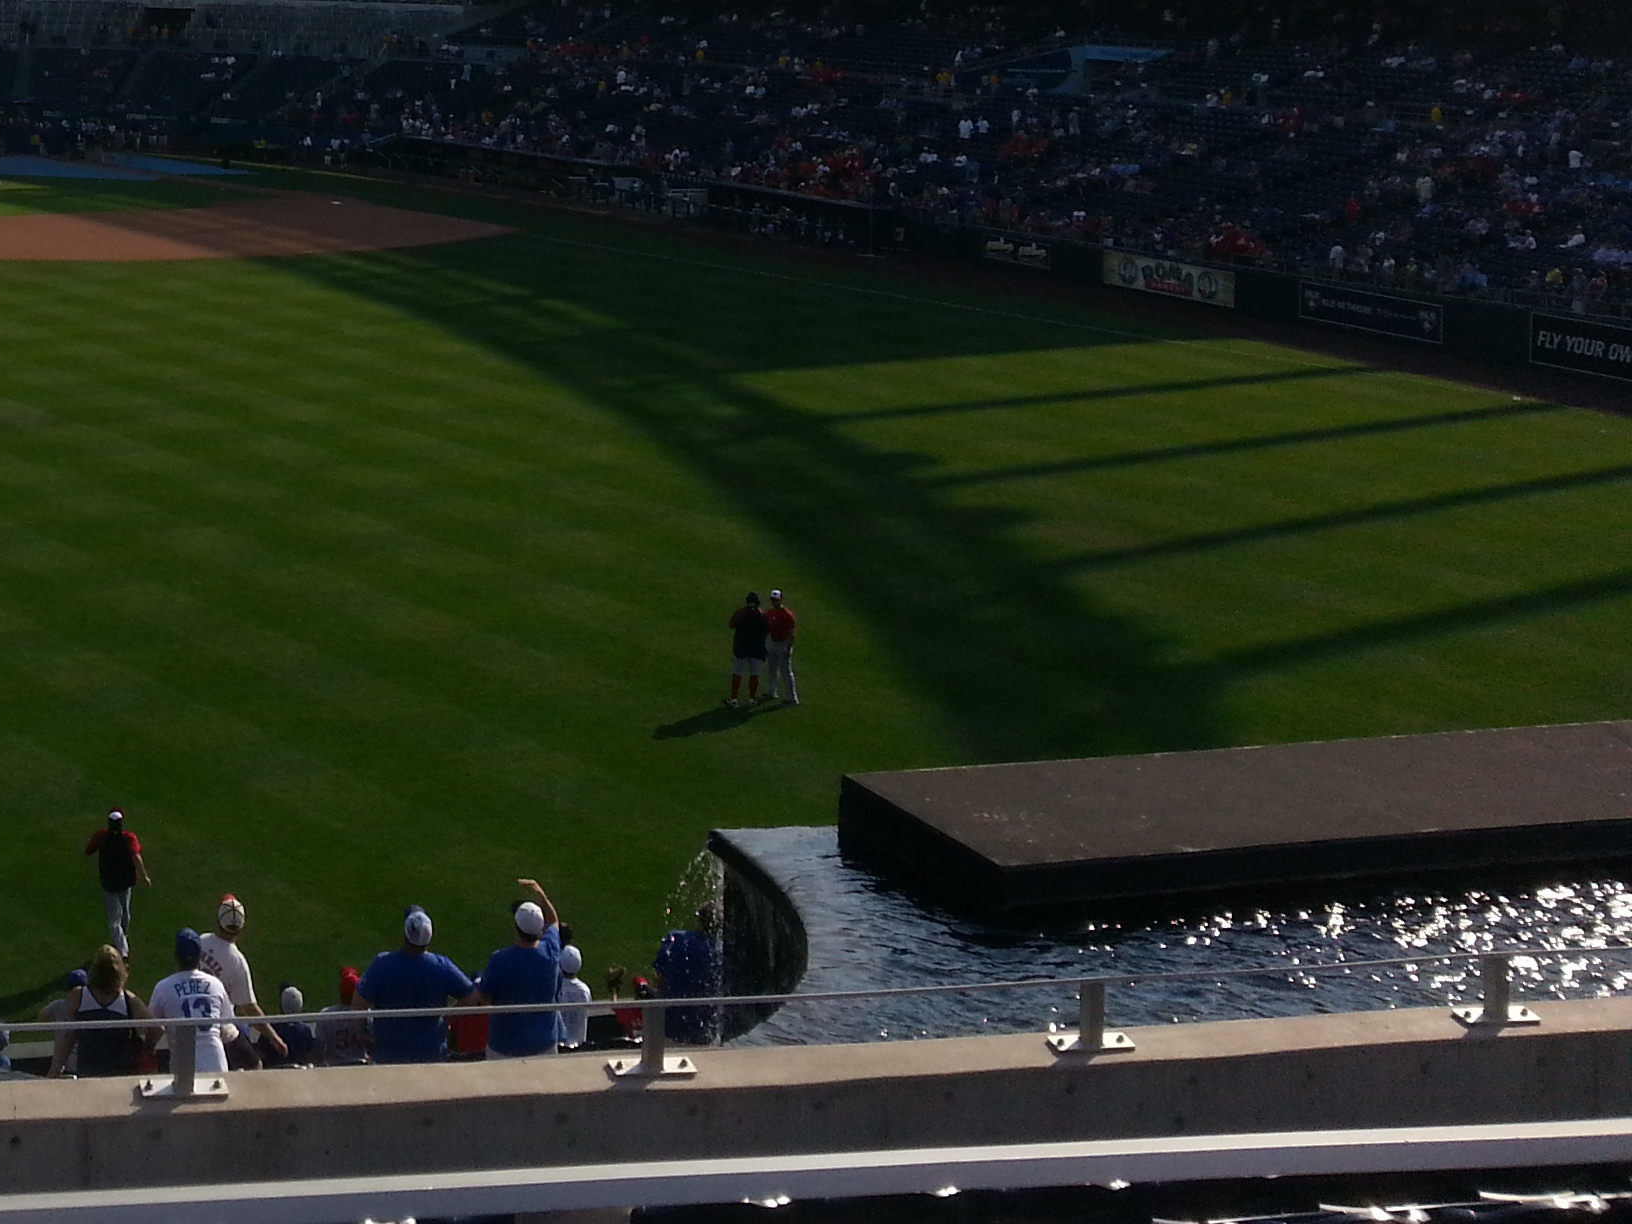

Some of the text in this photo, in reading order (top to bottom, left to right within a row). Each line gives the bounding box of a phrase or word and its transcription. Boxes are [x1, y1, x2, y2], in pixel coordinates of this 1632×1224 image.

[1536, 330, 1562, 350] FLY
[1566, 335, 1605, 358] YOUR
[174, 980, 212, 997] PEREZ
